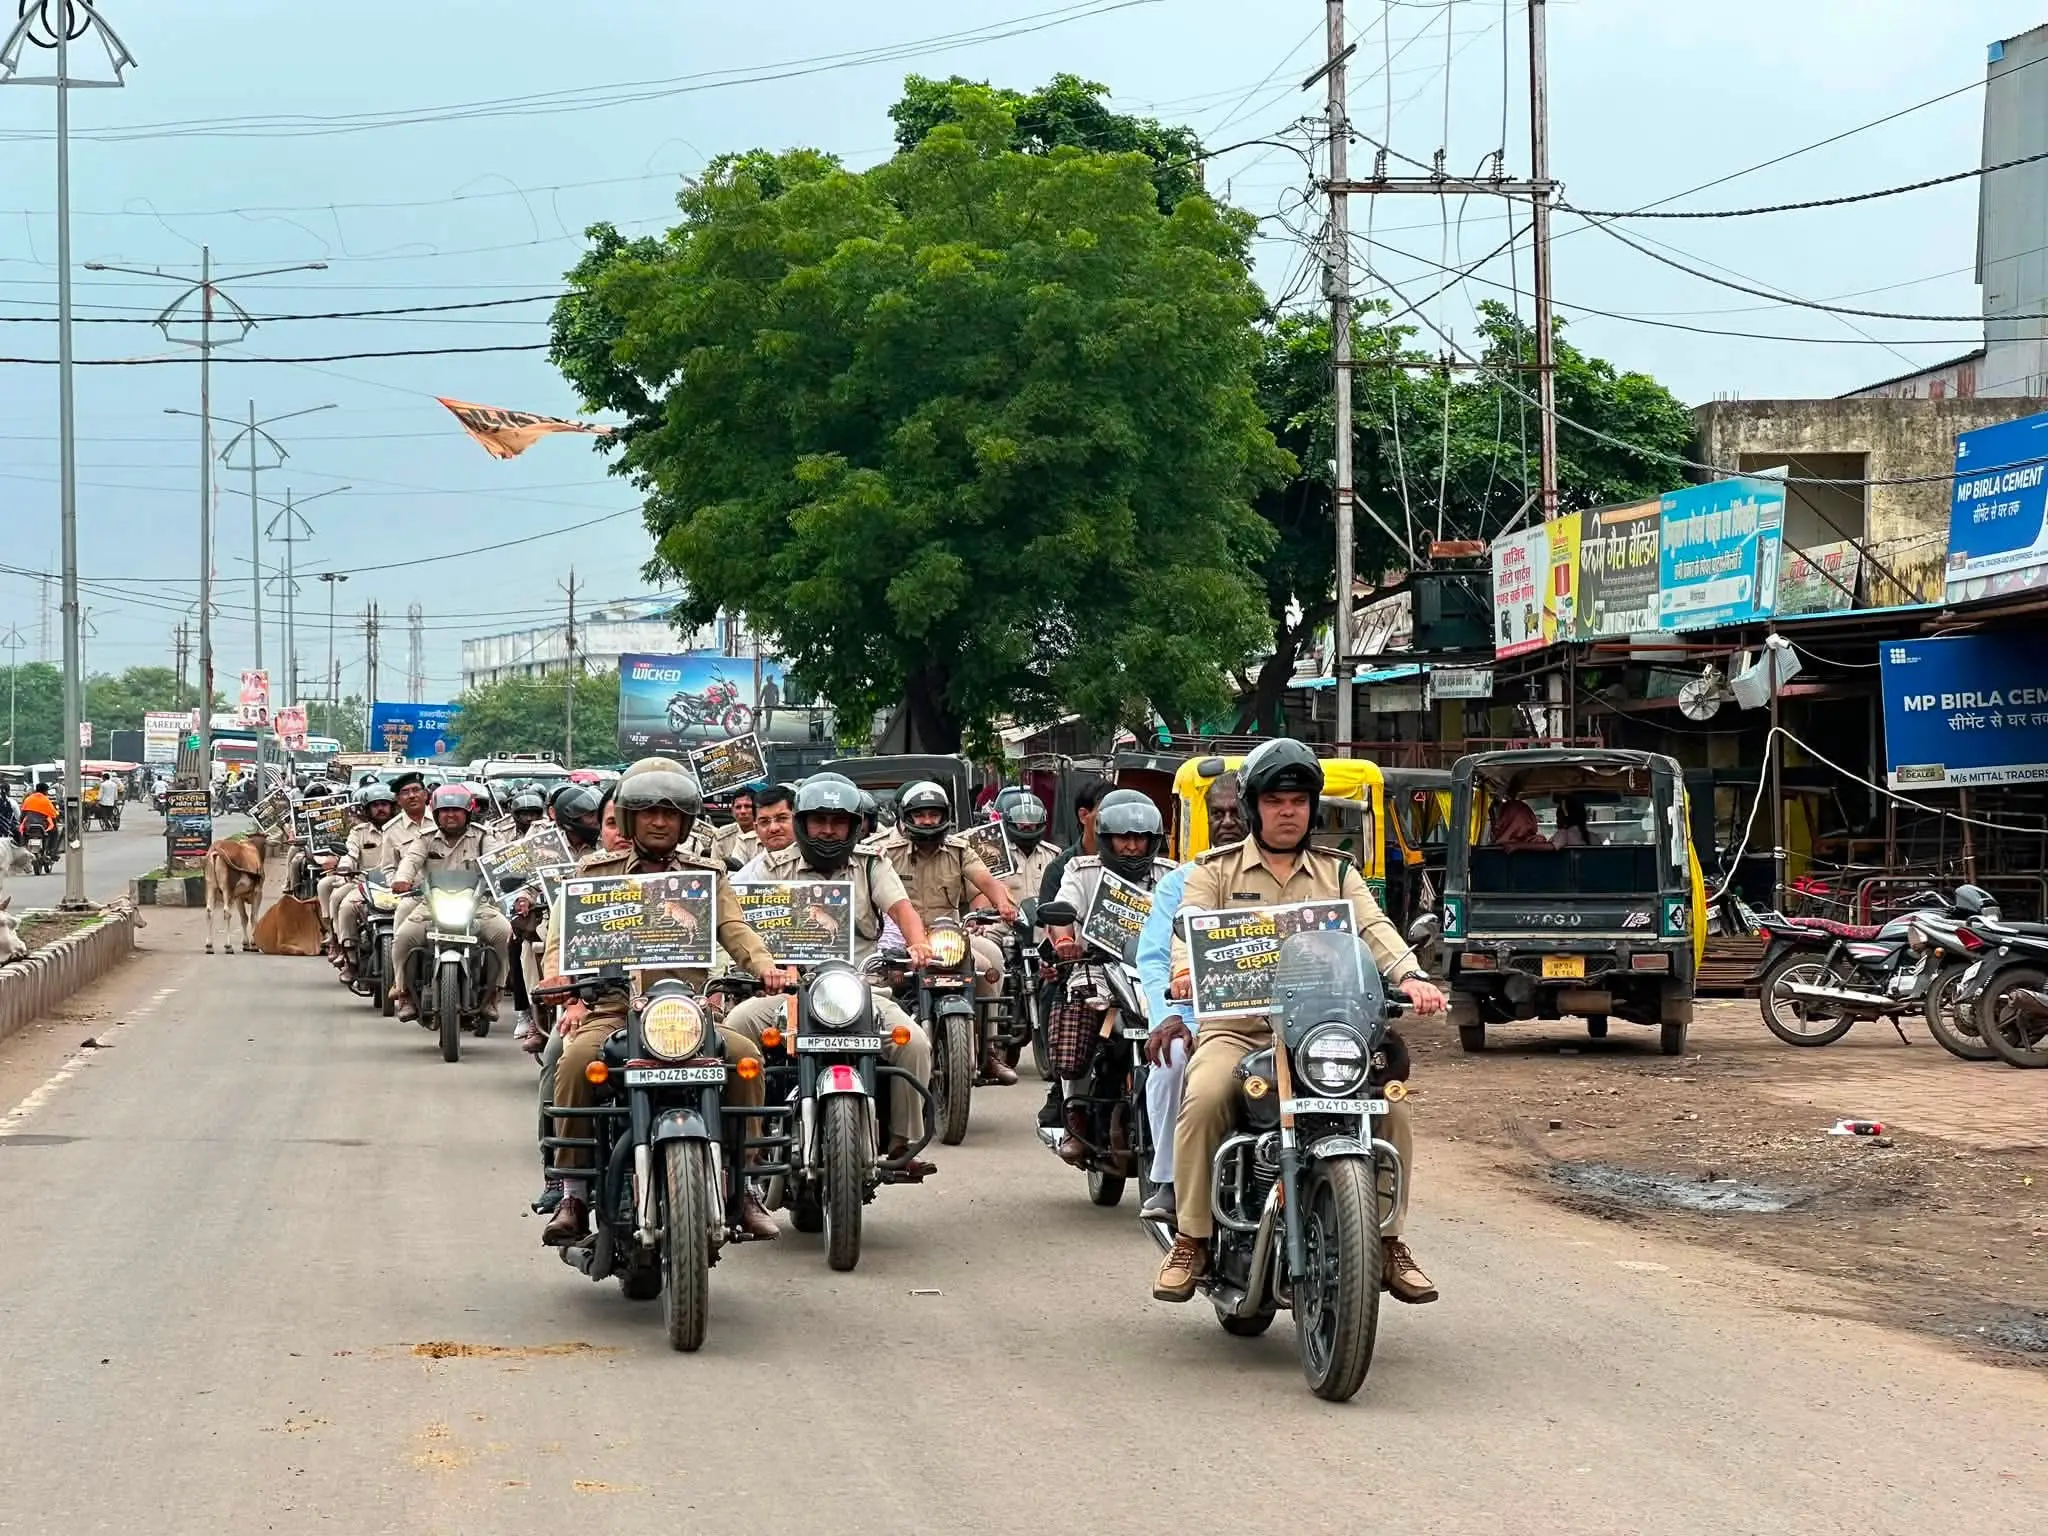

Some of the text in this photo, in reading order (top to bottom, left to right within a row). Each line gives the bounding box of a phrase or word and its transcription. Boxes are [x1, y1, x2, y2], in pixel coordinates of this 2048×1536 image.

[1957, 465, 2045, 503] MP BIRLA CEMENT
[1971, 502, 1989, 524] सीमेंट
[2008, 500, 2021, 517] तक
[632, 667, 681, 682] WICKED
[1904, 694, 1936, 712] MP
[1941, 690, 2005, 710] BIRLA
[147, 720, 180, 729] CAREER
[417, 719, 436, 729] 3.62
[1948, 712, 1986, 730] सीमेंट
[1990, 710, 2003, 728] से
[2007, 713, 2026, 727] घर
[1906, 771, 1936, 779] DEALER
[1950, 773, 1967, 785] M/s
[1969, 772, 2004, 783] MITTAL
[580, 894, 606, 905] बाघ
[610, 890, 642, 901] दिवस
[762, 894, 790, 905] दिवस
[1109, 887, 1128, 903] बाघ
[582, 905, 637, 924] राइड फॉर
[601, 915, 645, 931] टाइगर
[756, 917, 792, 929] टाइगर
[1207, 927, 1236, 941] बाघ
[1241, 923, 1276, 937] दिवस
[1213, 940, 1272, 961] राइड फॉर
[1235, 953, 1280, 970] टाइगर
